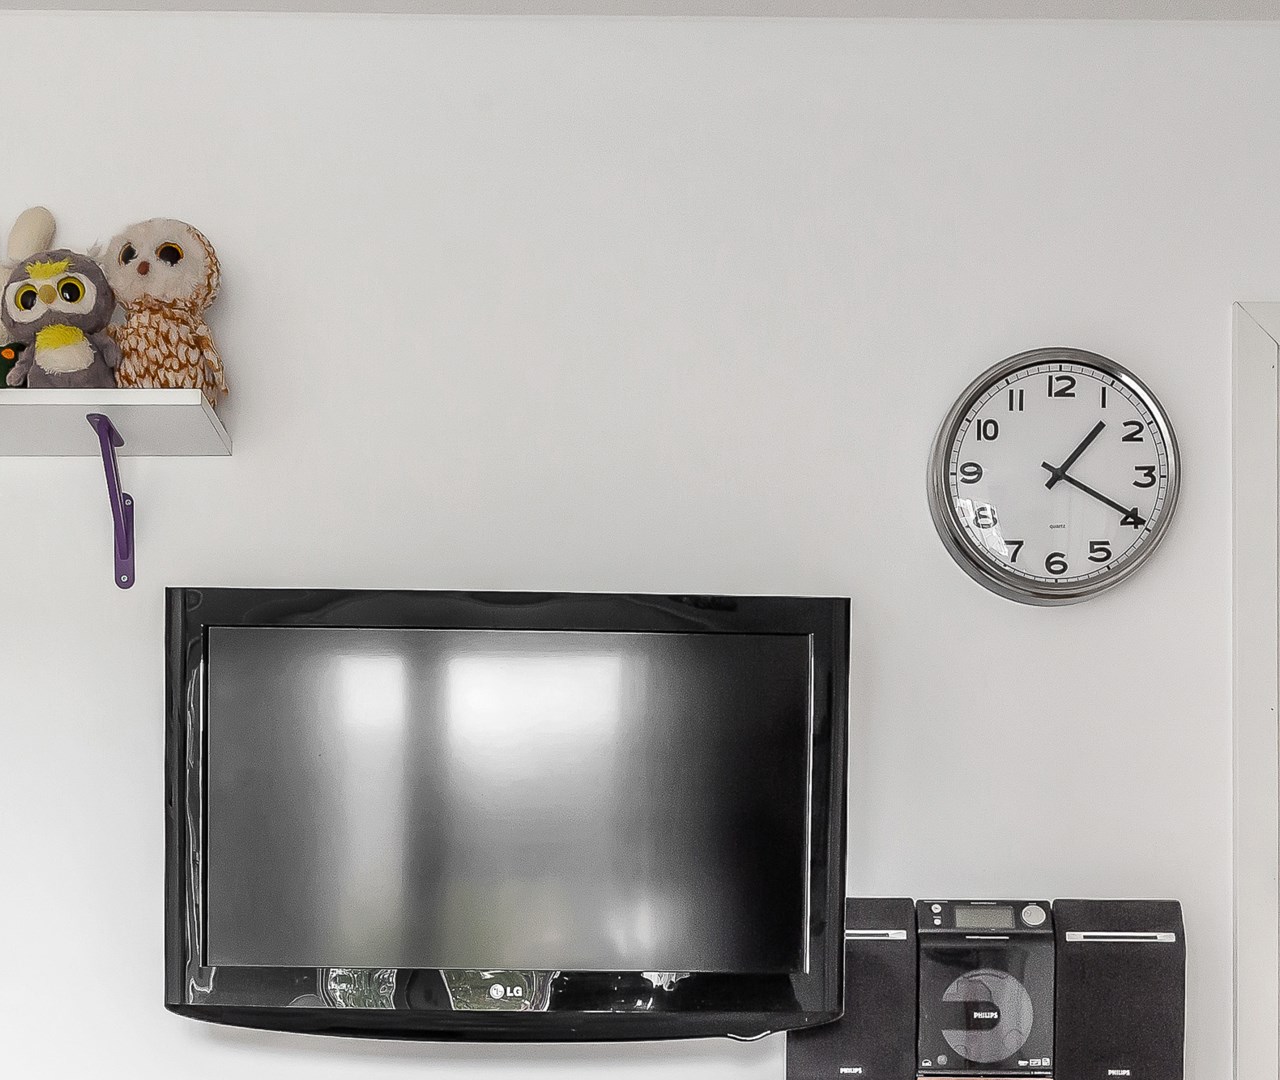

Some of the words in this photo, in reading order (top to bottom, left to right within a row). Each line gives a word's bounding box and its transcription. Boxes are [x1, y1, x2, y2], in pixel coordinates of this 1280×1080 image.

[1047, 375, 1076, 398] 12
[1101, 386, 1107, 408] 1
[1008, 388, 1024, 411] 11
[976, 419, 999, 441] 10
[1122, 420, 1144, 442] 2
[960, 462, 983, 484] 9
[1133, 465, 1156, 488] 3
[1120, 507, 1146, 529] 4
[1005, 540, 1024, 563] 7
[1088, 540, 1112, 563] 5
[1045, 552, 1068, 574] 6
[506, 985, 523, 997] LG
[973, 1011, 998, 1019] PHILIPS
[839, 1067, 863, 1075] PHILIPS
[1108, 1069, 1131, 1077] PHILIPS
